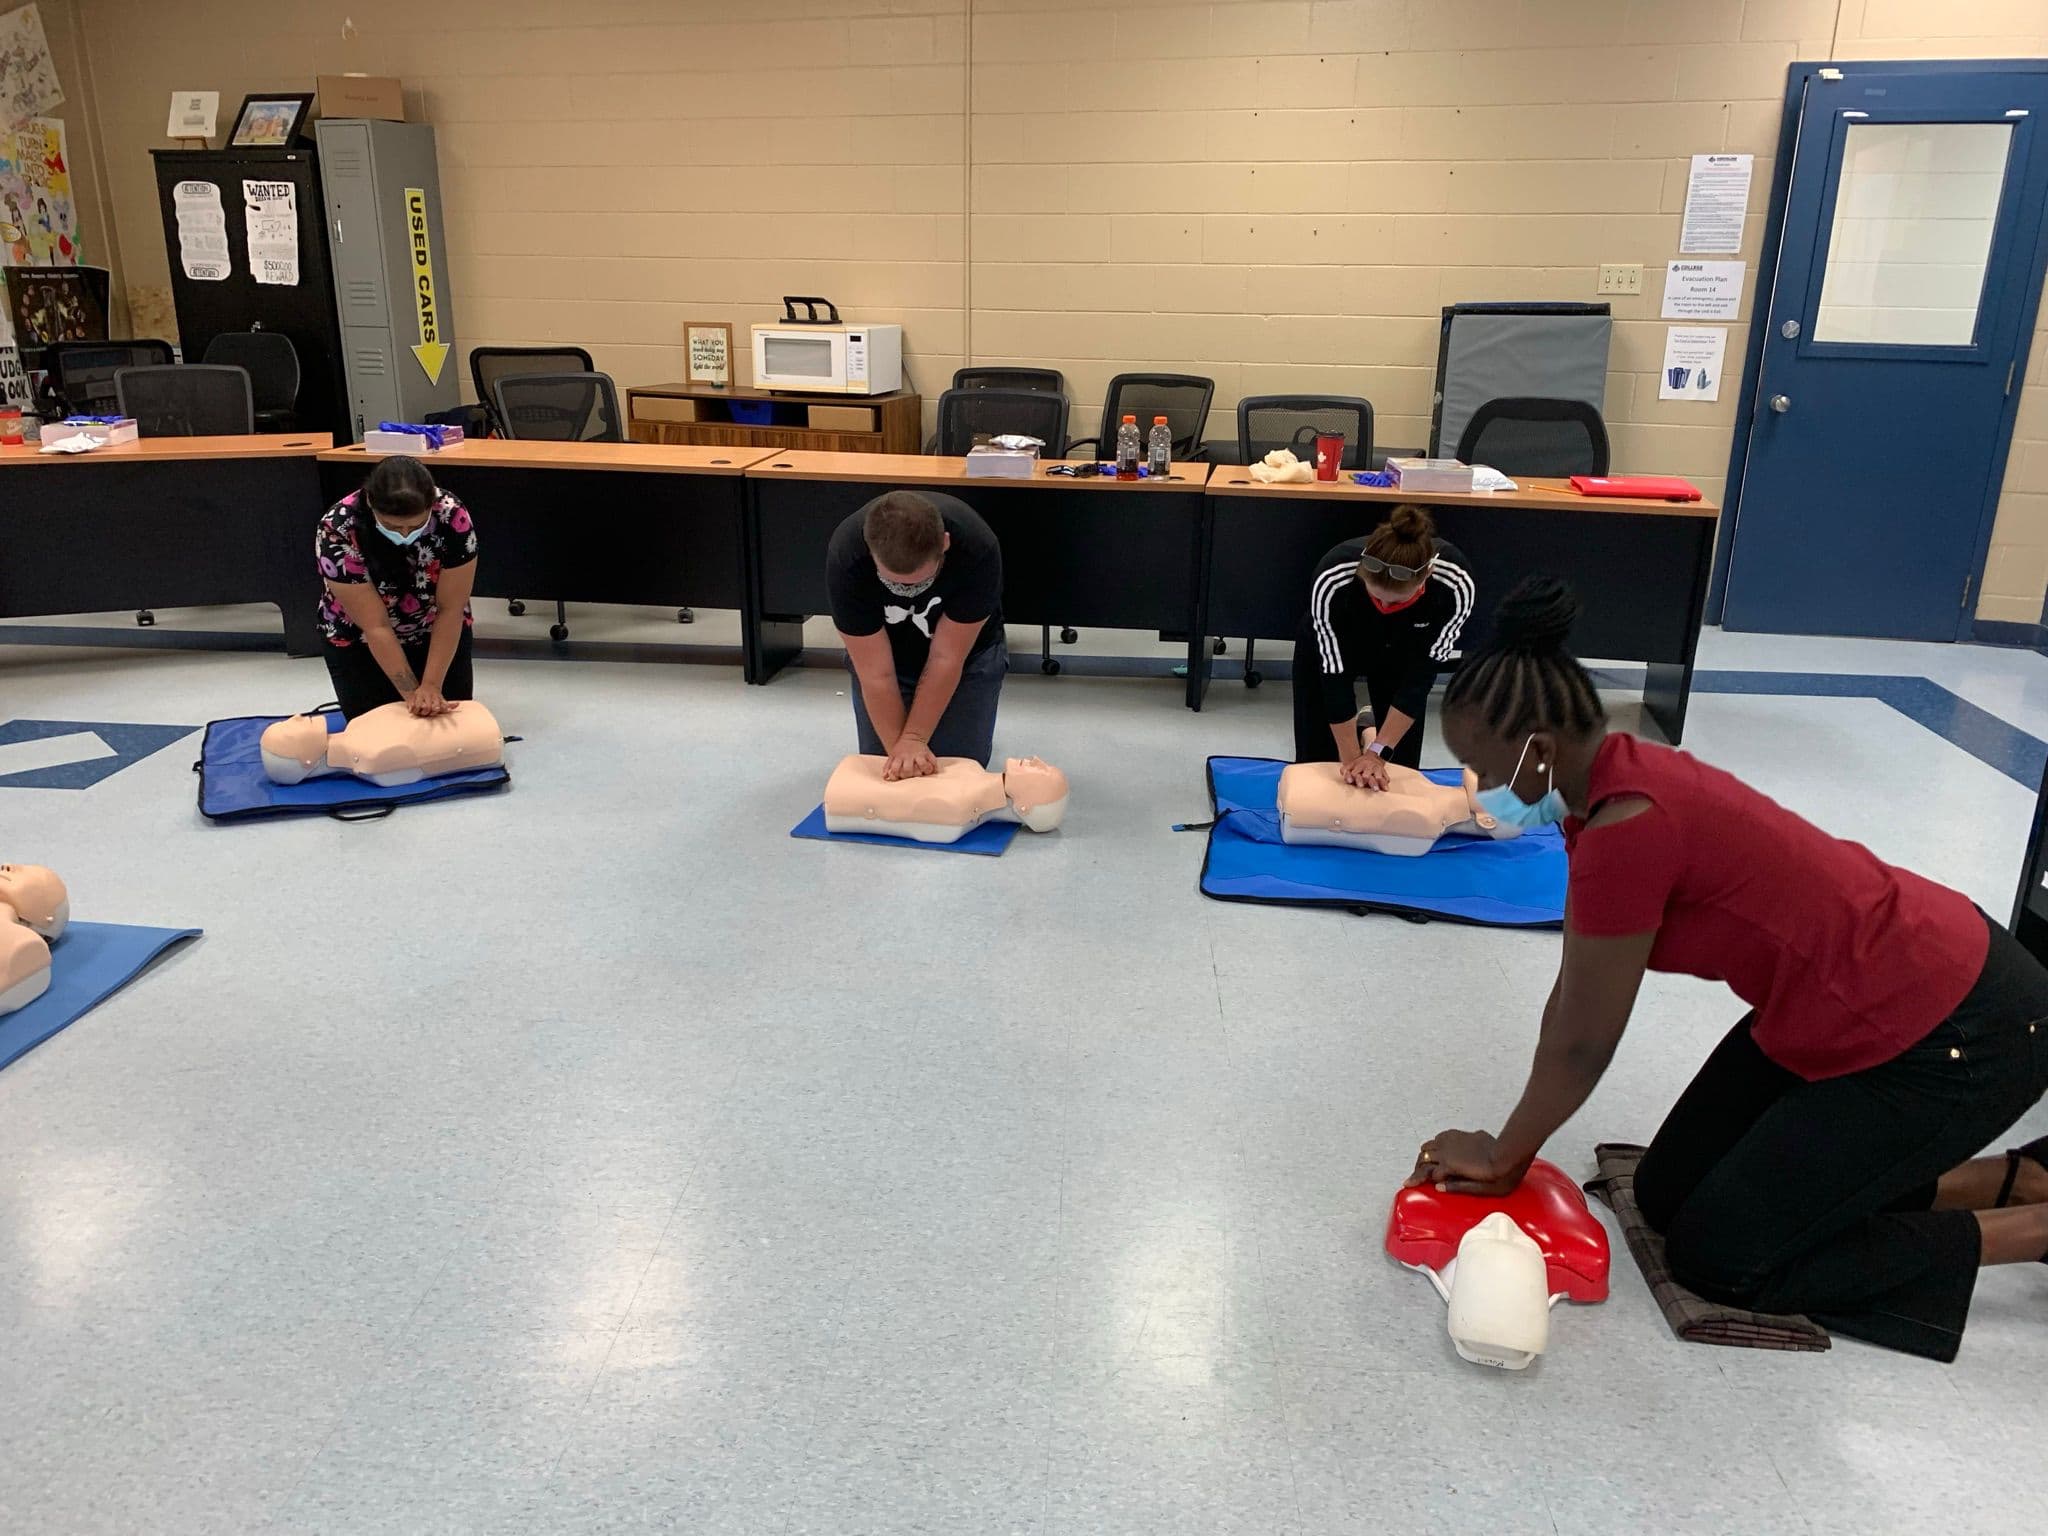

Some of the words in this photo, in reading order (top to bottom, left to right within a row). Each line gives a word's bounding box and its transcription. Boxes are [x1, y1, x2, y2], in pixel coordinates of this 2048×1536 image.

[246, 184, 290, 197] WANTED
[410, 196, 427, 266] USED
[265, 271, 294, 281] REWARD
[418, 275, 436, 343] CARS
